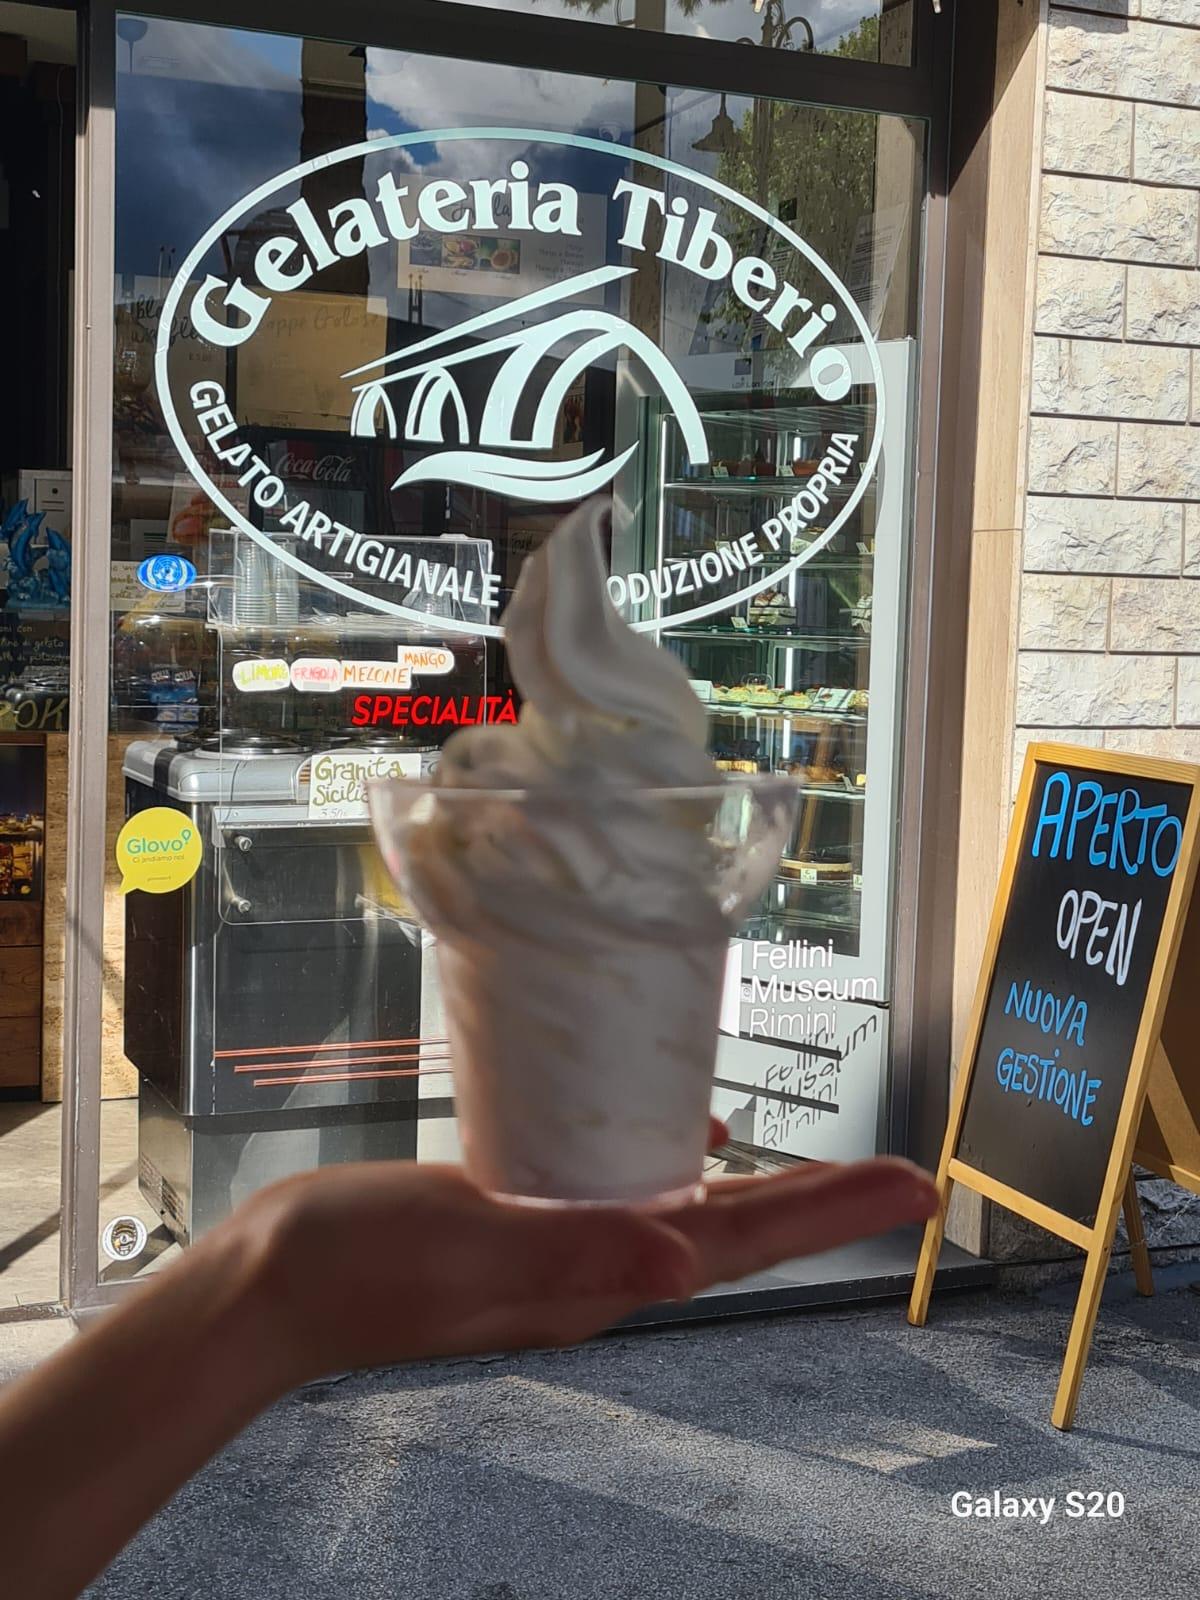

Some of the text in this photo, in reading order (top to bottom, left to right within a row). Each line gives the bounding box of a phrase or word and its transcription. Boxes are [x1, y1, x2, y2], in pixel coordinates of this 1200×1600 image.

[190, 160, 853, 402] Gelateria Tiberio
[190, 380, 860, 608] GELATO ARTIGIANALE ODUZIONE PROPRIA
[293, 666, 338, 683] FRAGOLA
[343, 665, 409, 685] MELONE
[404, 653, 446, 667] MANGO
[352, 689, 518, 727] SPECIALITÀ
[314, 755, 407, 783] Granita
[1032, 771, 1183, 877] APERTO
[127, 835, 185, 855] Glovo
[1056, 889, 1143, 986] OPEN
[752, 938, 834, 971] Fellini
[751, 974, 878, 1004] Museum
[749, 1006, 837, 1039] Rimini
[1004, 980, 1088, 1047] NUOVA
